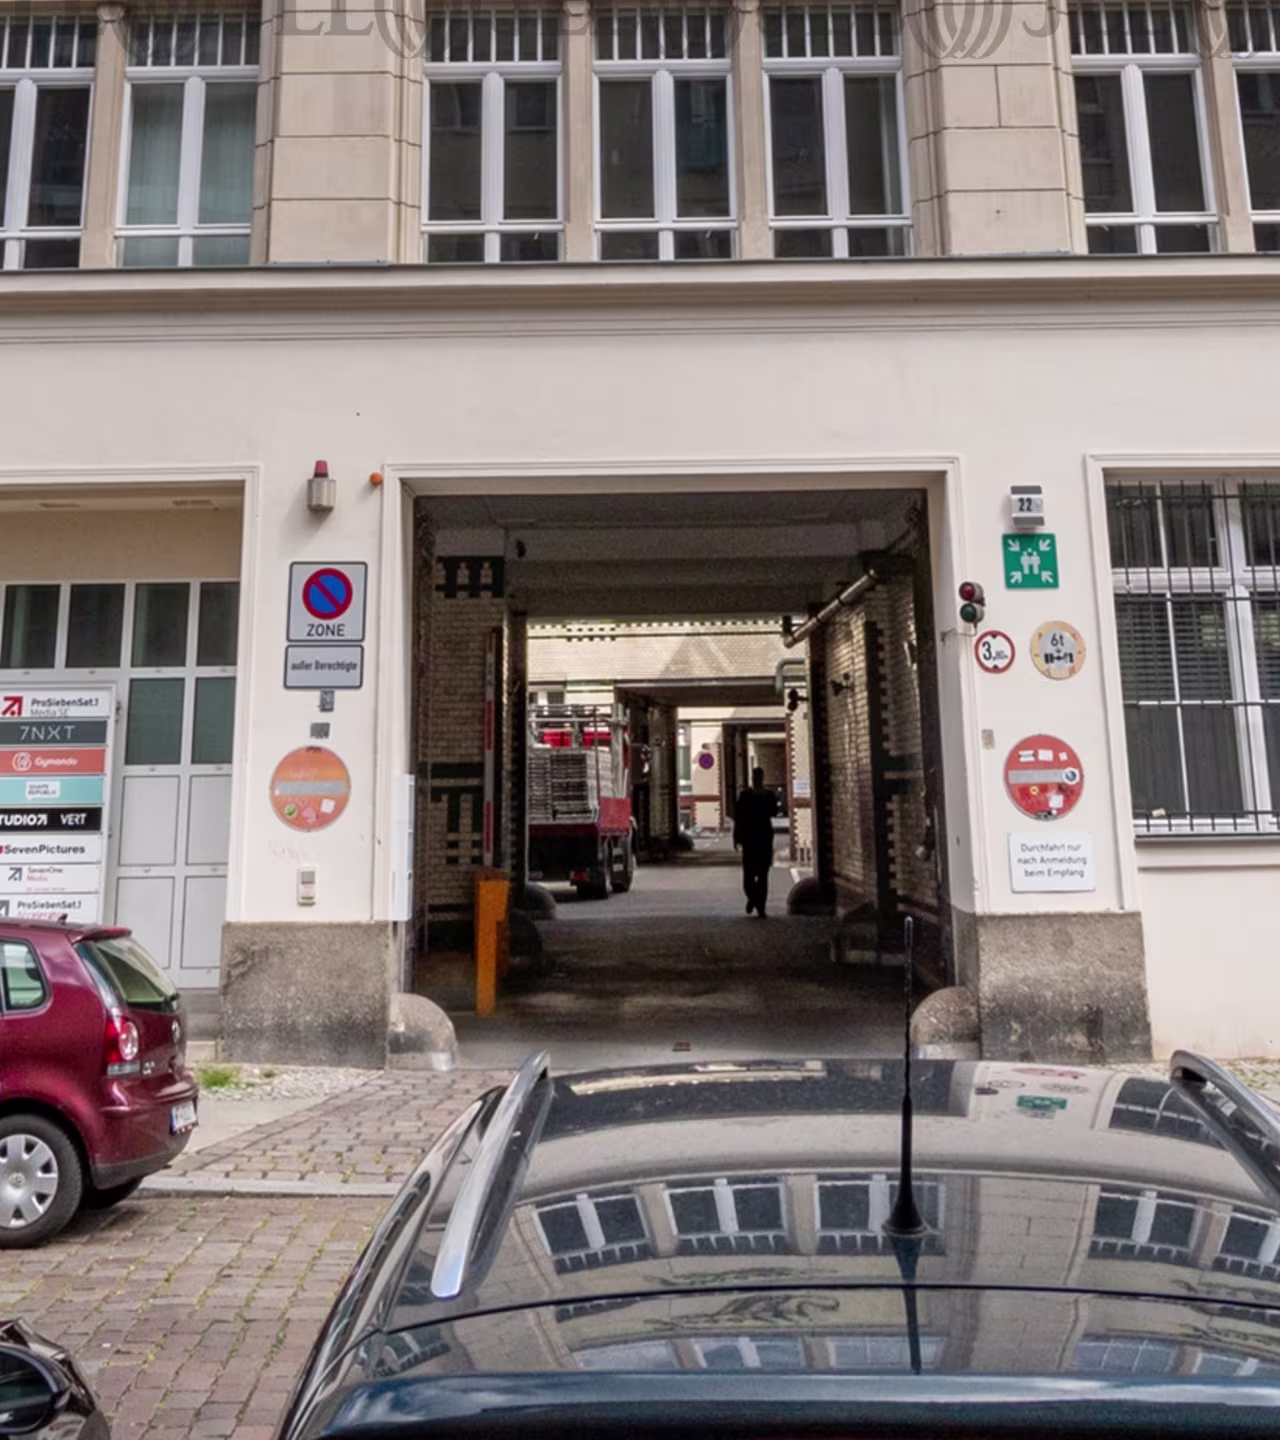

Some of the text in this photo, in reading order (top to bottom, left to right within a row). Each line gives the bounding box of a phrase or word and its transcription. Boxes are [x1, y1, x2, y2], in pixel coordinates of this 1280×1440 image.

[306, 623, 346, 638] ZONE
[20, 725, 76, 741] 7NXT
[34, 756, 79, 768] Gymondo
[60, 813, 87, 825] VERT
[4, 844, 86, 854] SevenPictures
[1021, 843, 1065, 852] Durchfahrt
[1018, 856, 1087, 866] nach Anmeldung
[1024, 868, 1084, 879] beim Empfang
